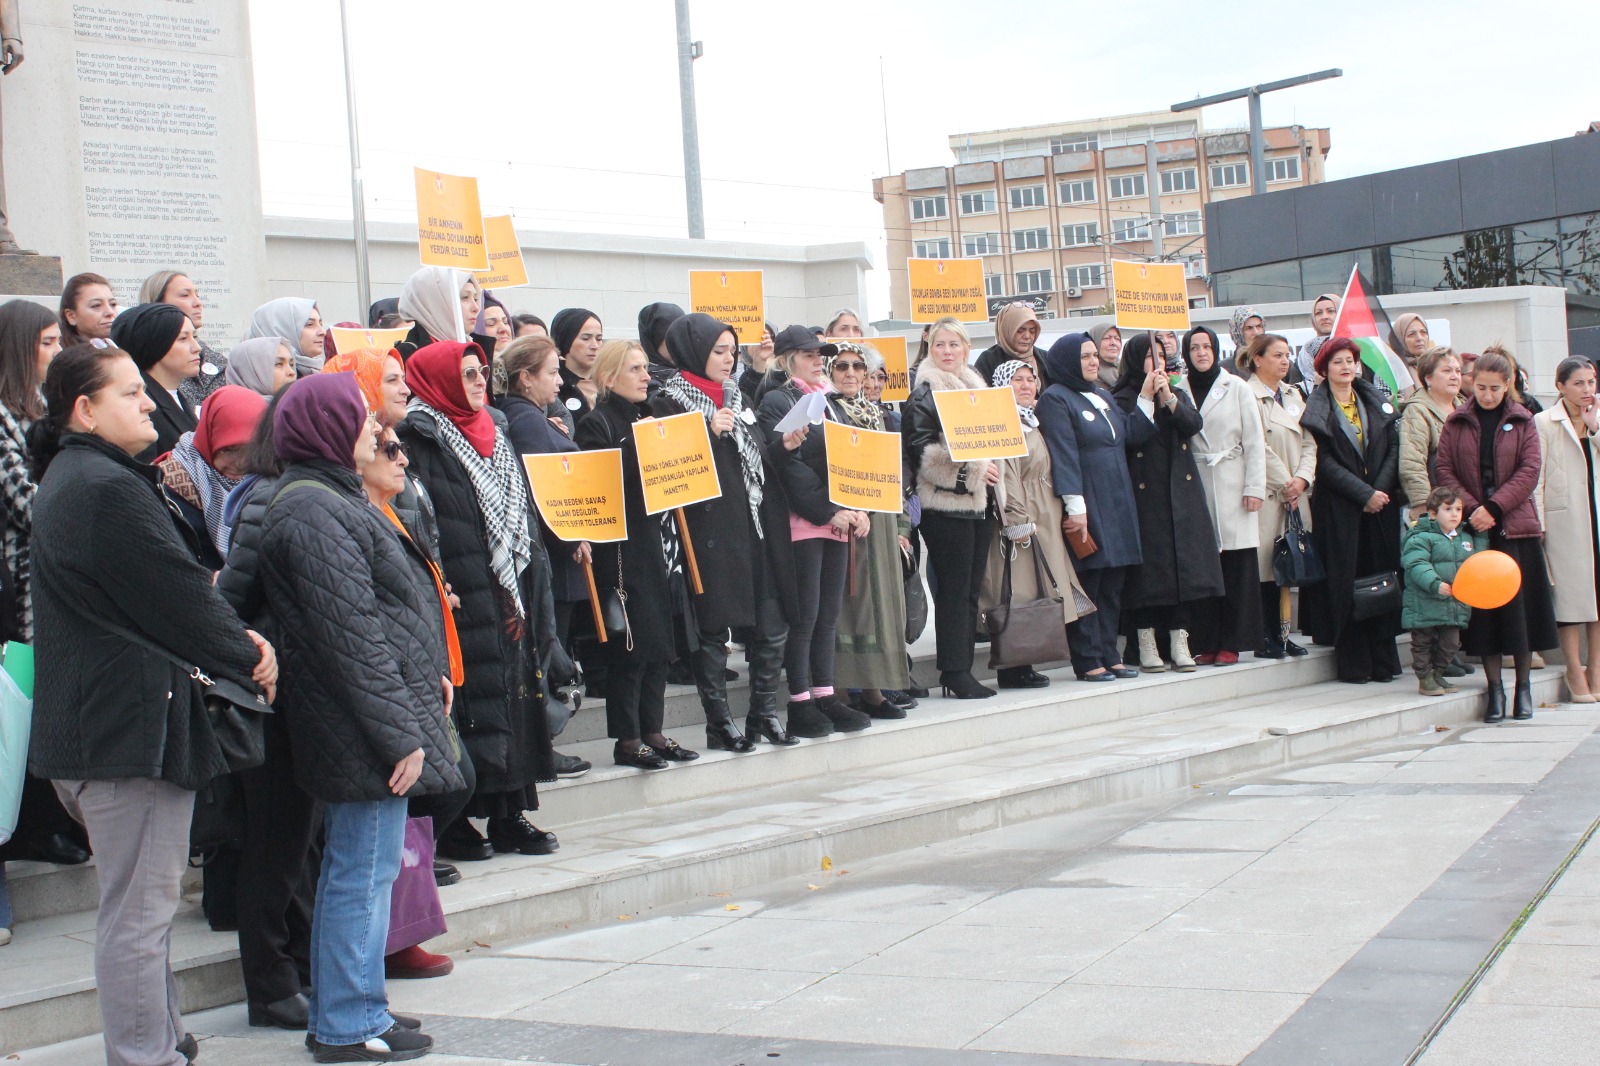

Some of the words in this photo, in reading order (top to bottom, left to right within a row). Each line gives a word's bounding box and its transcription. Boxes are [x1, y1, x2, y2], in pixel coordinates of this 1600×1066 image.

[428, 216, 438, 227] BİR
[439, 218, 463, 231] ANNENİN
[447, 232, 483, 245] DOYAMADIĞI
[430, 244, 450, 255] YERDİR
[451, 246, 469, 258] GAZZE
[942, 286, 950, 298] SESİ
[1116, 290, 1132, 300] GAZZE
[1132, 292, 1140, 300] DE
[1141, 292, 1168, 302] SOYKIRIM
[1170, 292, 1184, 302] VAR
[1138, 304, 1153, 314] SIFIR
[1153, 304, 1186, 314] TOLERANS
[954, 426, 986, 437] BEŞİKLERE
[987, 422, 1008, 434] MERMİ
[1001, 437, 1022, 447] DOLDU
[659, 458, 680, 470] YÖNELİK
[680, 453, 703, 464] YAPILAN
[686, 465, 709, 476] YAPILAN
[663, 483, 690, 496] İHANETTİR
[564, 497, 584, 506] BEDENİ
[585, 496, 606, 506] SAVAŞ
[572, 506, 599, 516] DEĞİLDİR.
[584, 516, 617, 526] TOLERANS
